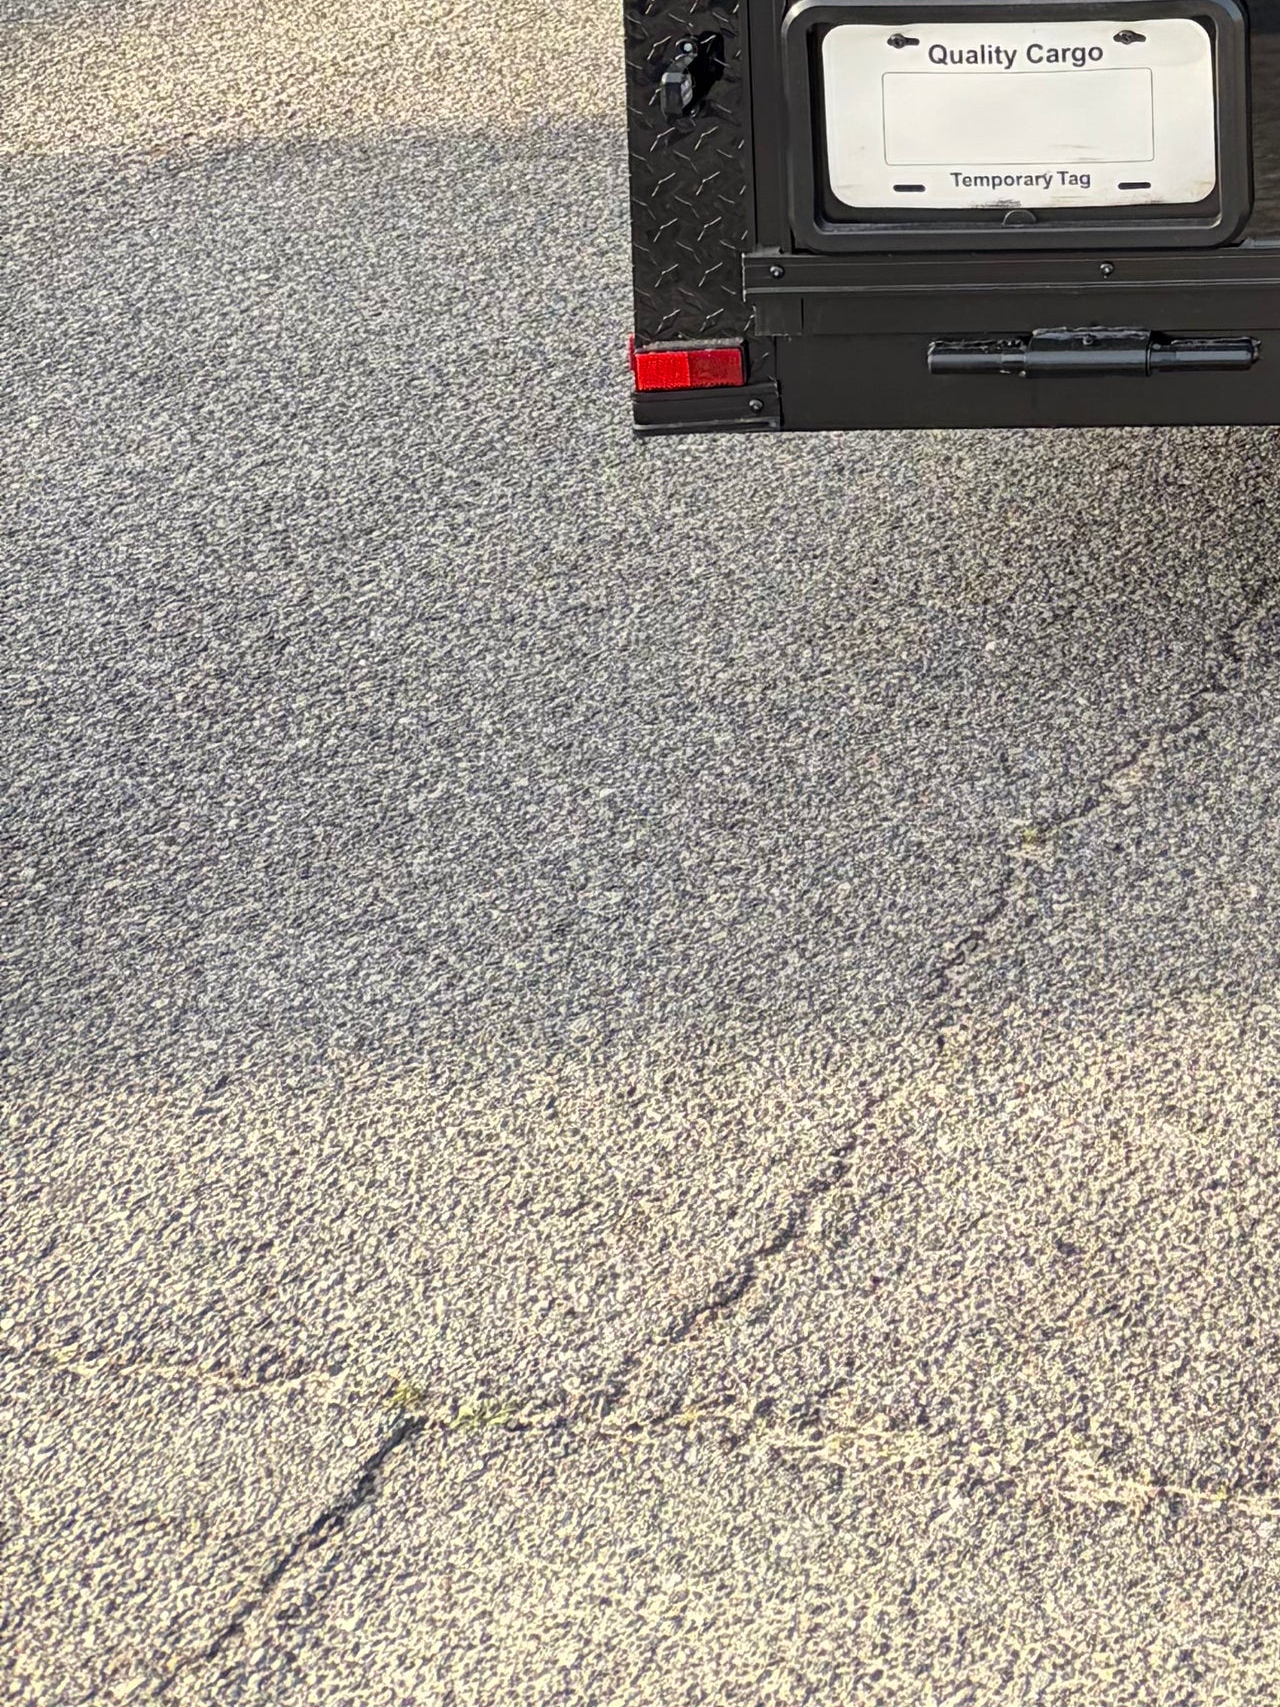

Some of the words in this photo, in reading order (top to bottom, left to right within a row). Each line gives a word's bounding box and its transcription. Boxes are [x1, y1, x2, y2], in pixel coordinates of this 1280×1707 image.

[927, 43, 1018, 70] Quality
[1026, 43, 1104, 68] Cargo
[949, 171, 1053, 190] Temporary
[1056, 170, 1092, 189] Tag
